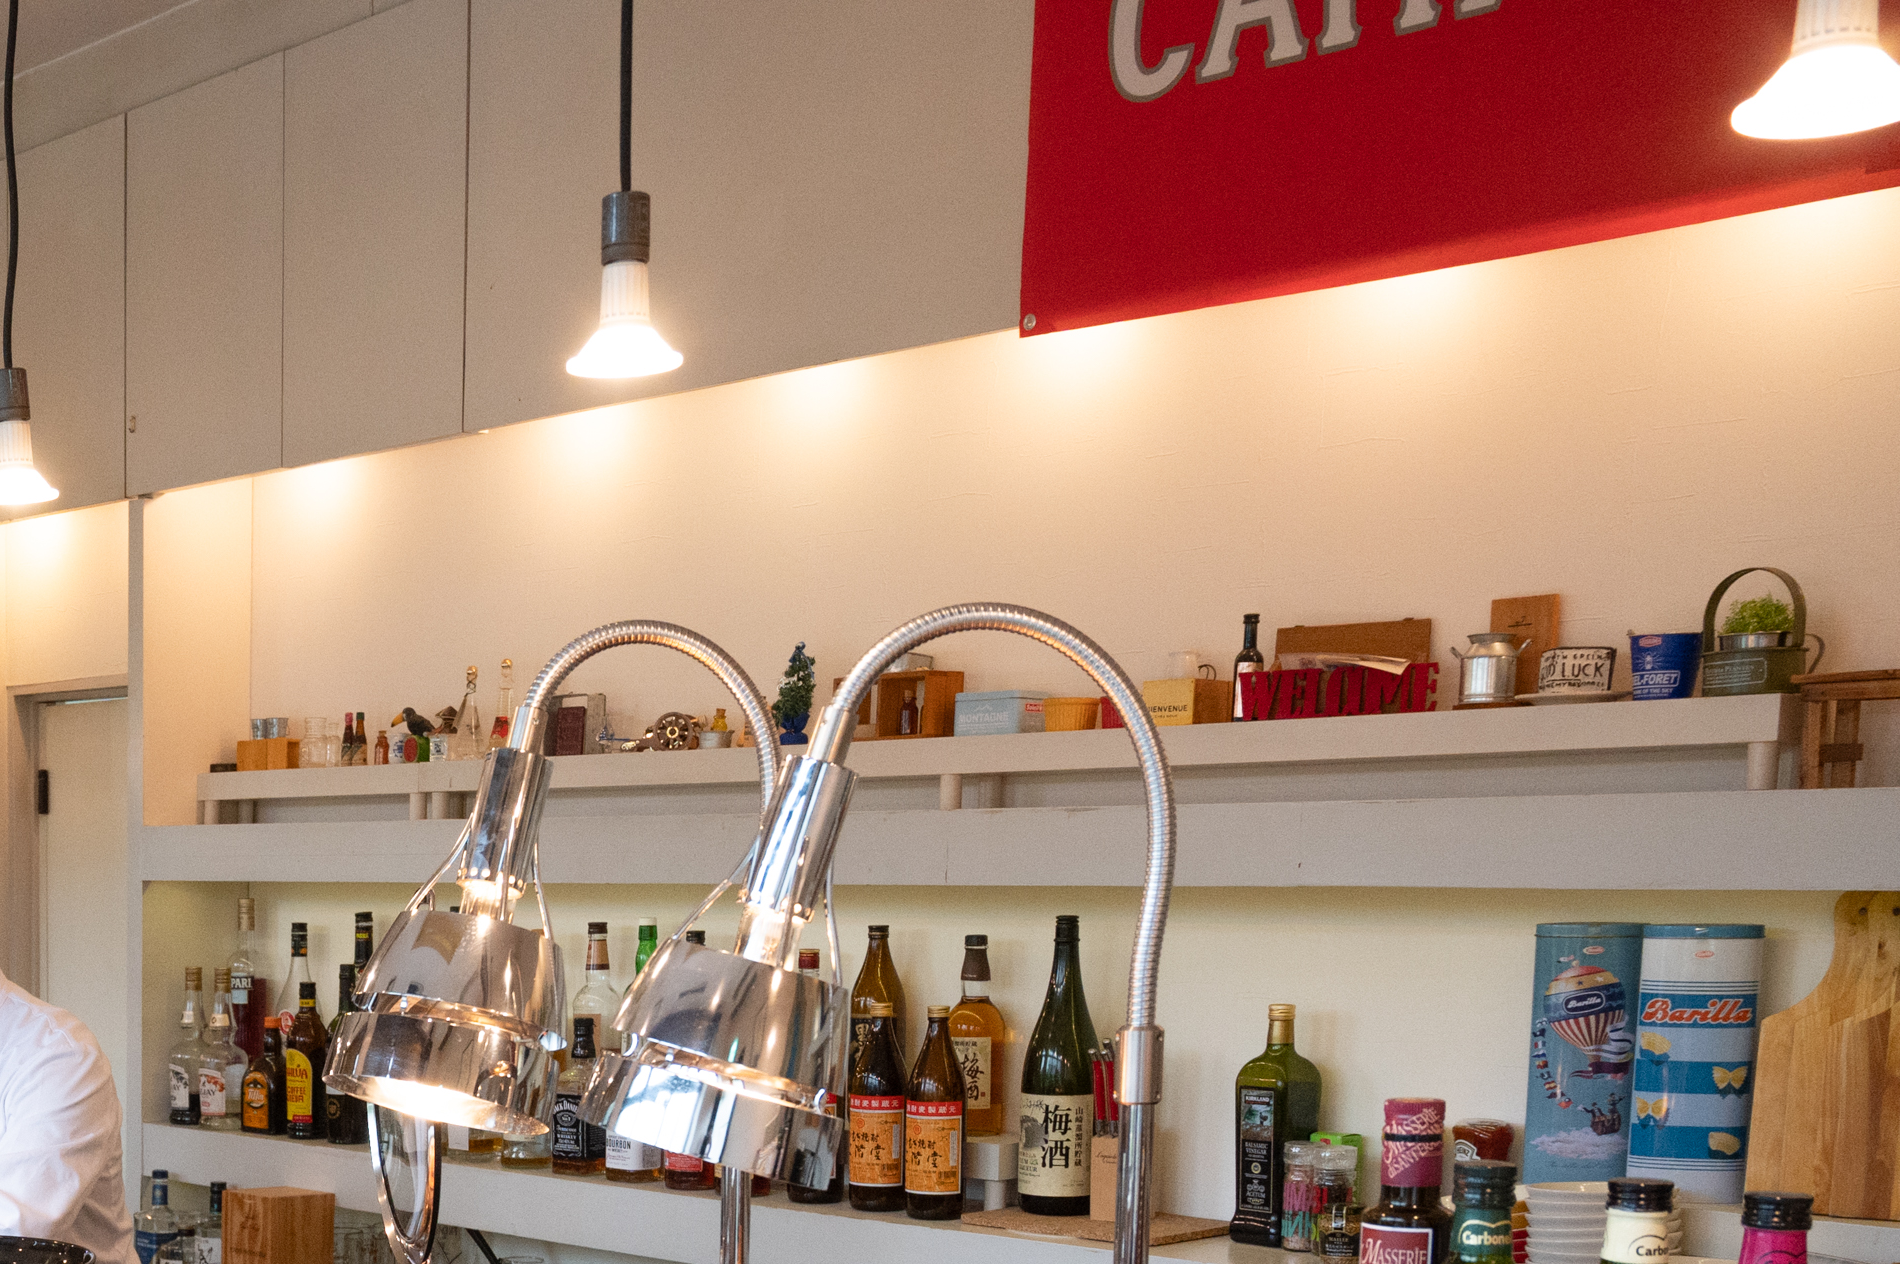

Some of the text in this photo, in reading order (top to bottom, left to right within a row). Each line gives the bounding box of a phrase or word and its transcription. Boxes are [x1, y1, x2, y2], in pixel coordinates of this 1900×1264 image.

[1562, 661, 1605, 678] LUCK
[1149, 704, 1188, 713] IENVENUE
[1641, 997, 1754, 1025] Barilla
[1040, 1104, 1073, 1169] 梅酒
